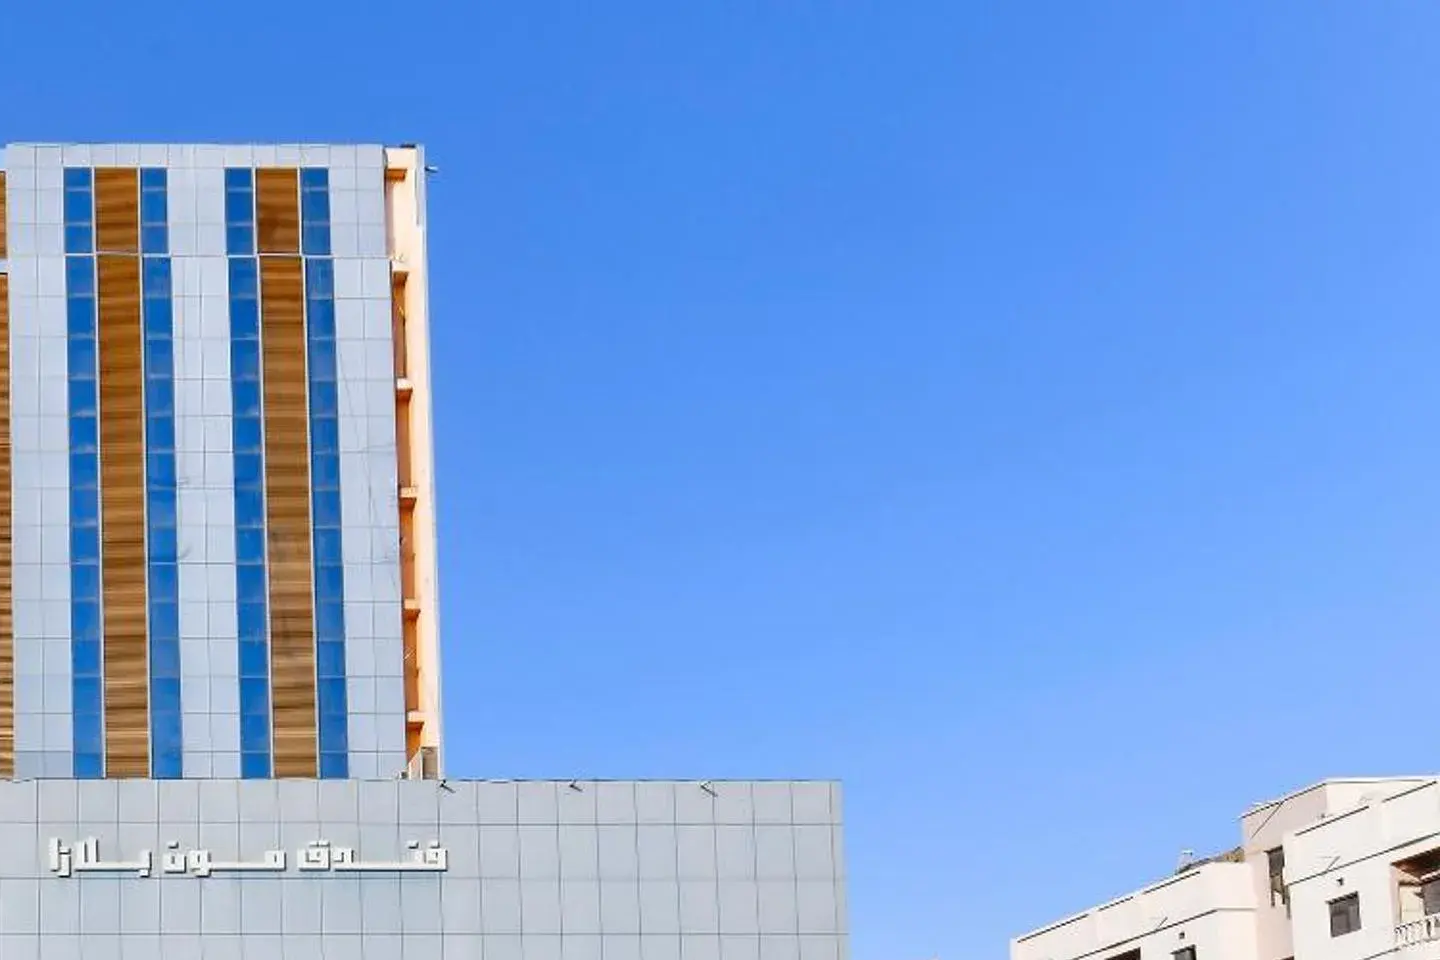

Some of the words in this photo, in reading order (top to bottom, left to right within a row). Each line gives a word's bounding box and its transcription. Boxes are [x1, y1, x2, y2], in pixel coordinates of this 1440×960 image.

[49, 836, 152, 878] بلازا
[164, 841, 286, 878] مون
[297, 839, 448, 873] فندق
